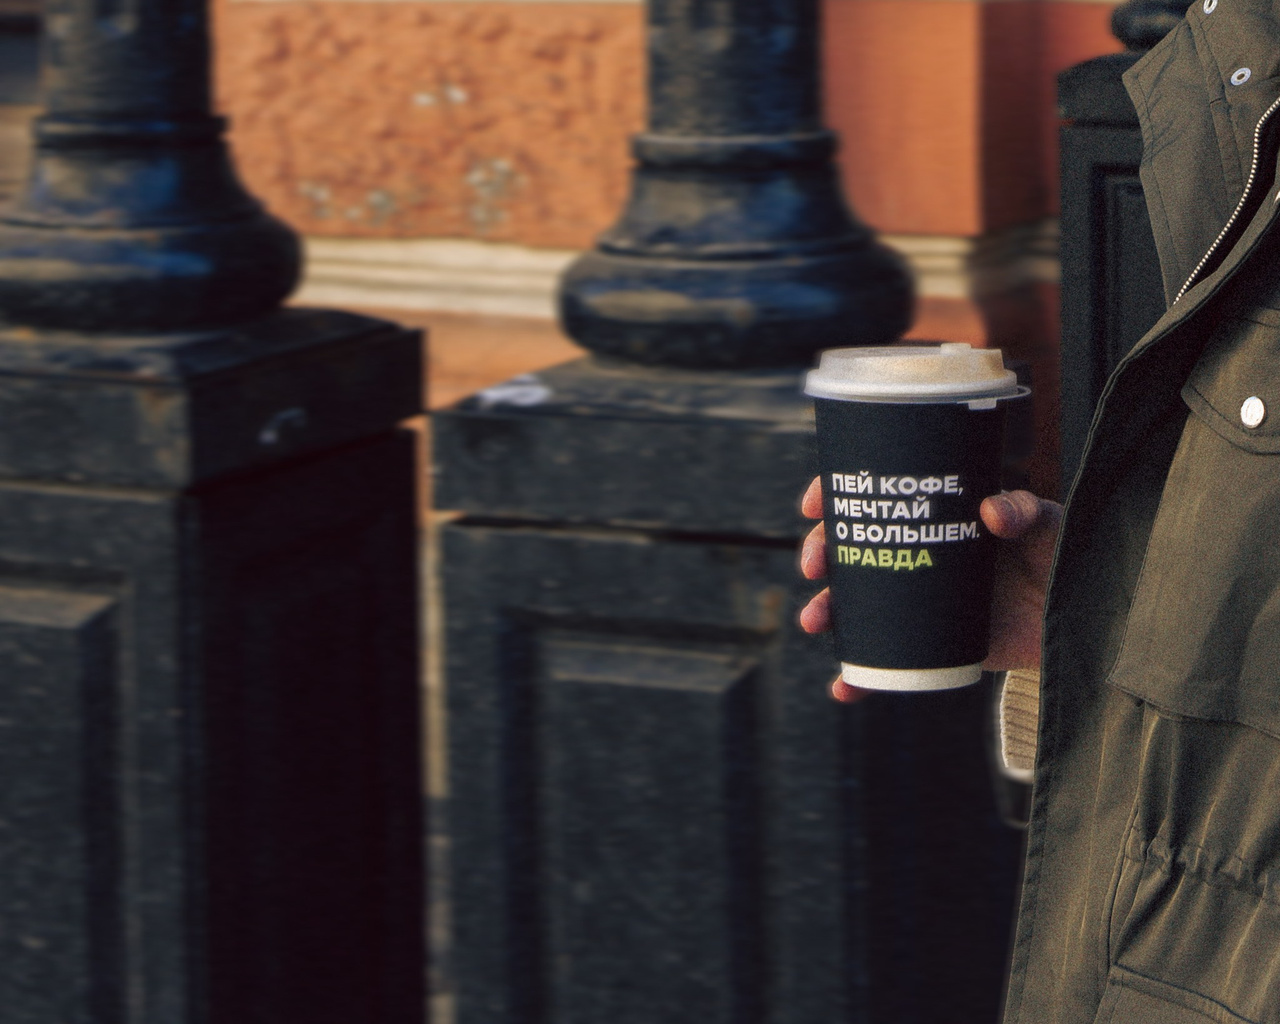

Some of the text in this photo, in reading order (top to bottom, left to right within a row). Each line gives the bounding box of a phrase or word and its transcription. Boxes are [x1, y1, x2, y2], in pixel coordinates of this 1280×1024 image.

[832, 470, 963, 496] ПЕЙ КОФЕ,
[833, 495, 930, 519] МЕЧТАЙ
[835, 521, 980, 543] О БОЛЬШЕМ.
[837, 545, 933, 571] ПРАВДА
